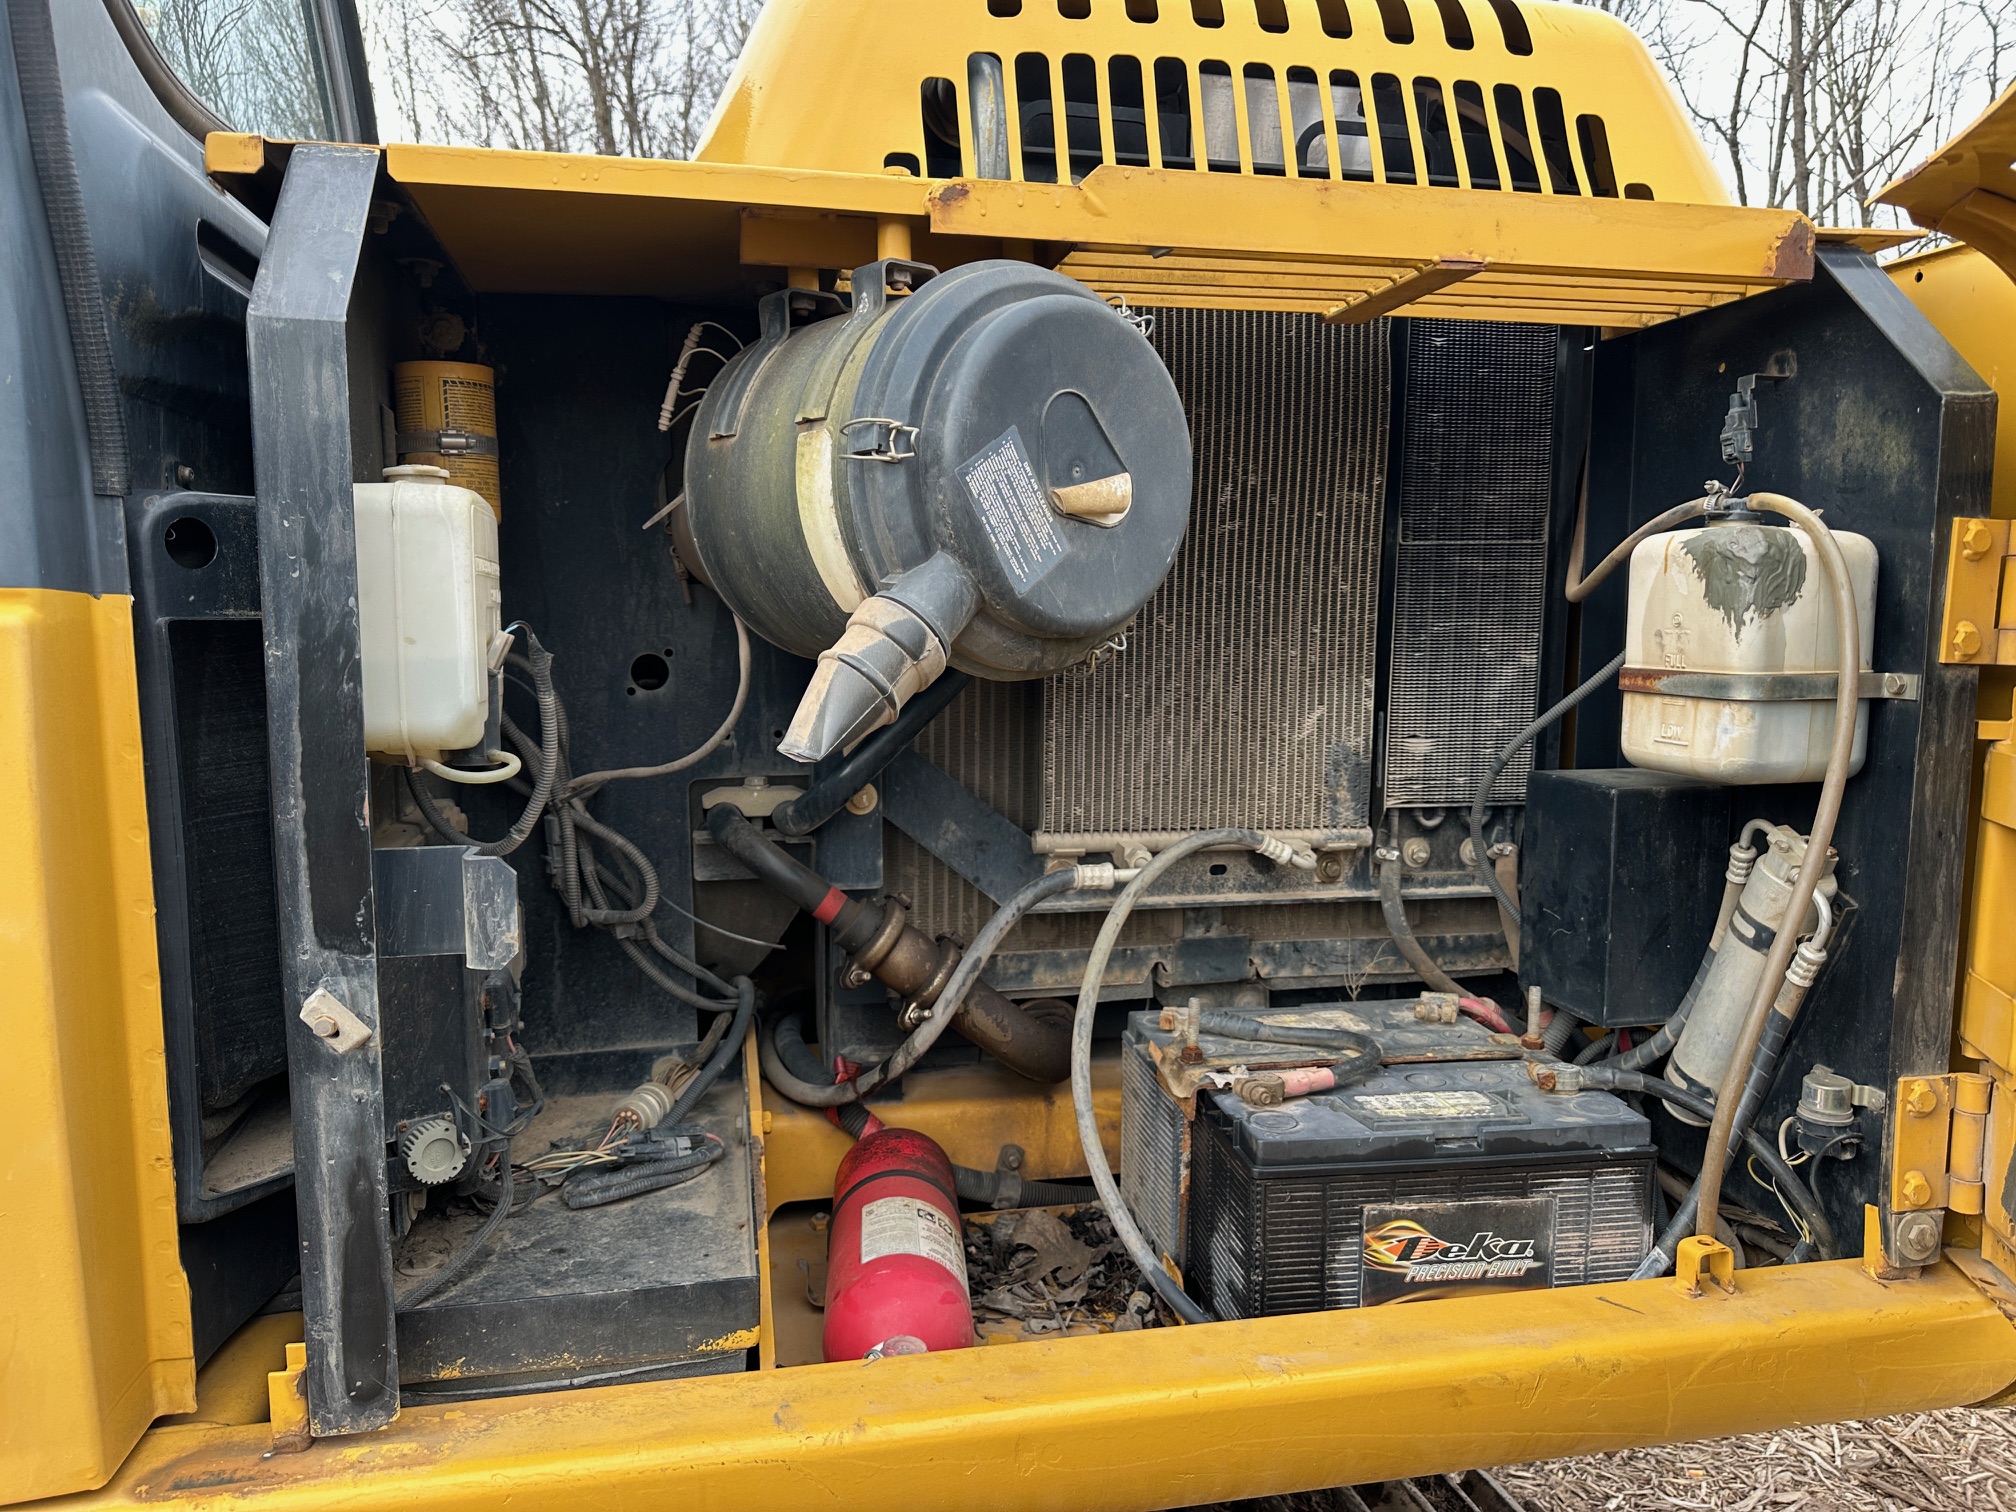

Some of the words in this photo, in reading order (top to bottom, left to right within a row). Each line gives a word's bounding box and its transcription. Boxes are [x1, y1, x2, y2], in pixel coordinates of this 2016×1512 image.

[1023, 461, 1032, 476] DRY
[1030, 477, 1038, 491] AIR
[1036, 491, 1053, 523] CLEANER
[1664, 653, 1687, 669] FULL
[1661, 723, 1684, 739] LOW
[1392, 1231, 1535, 1262] Deka
[1404, 1262, 1486, 1283] PRECISION
[1486, 1258, 1534, 1279] BUILT
